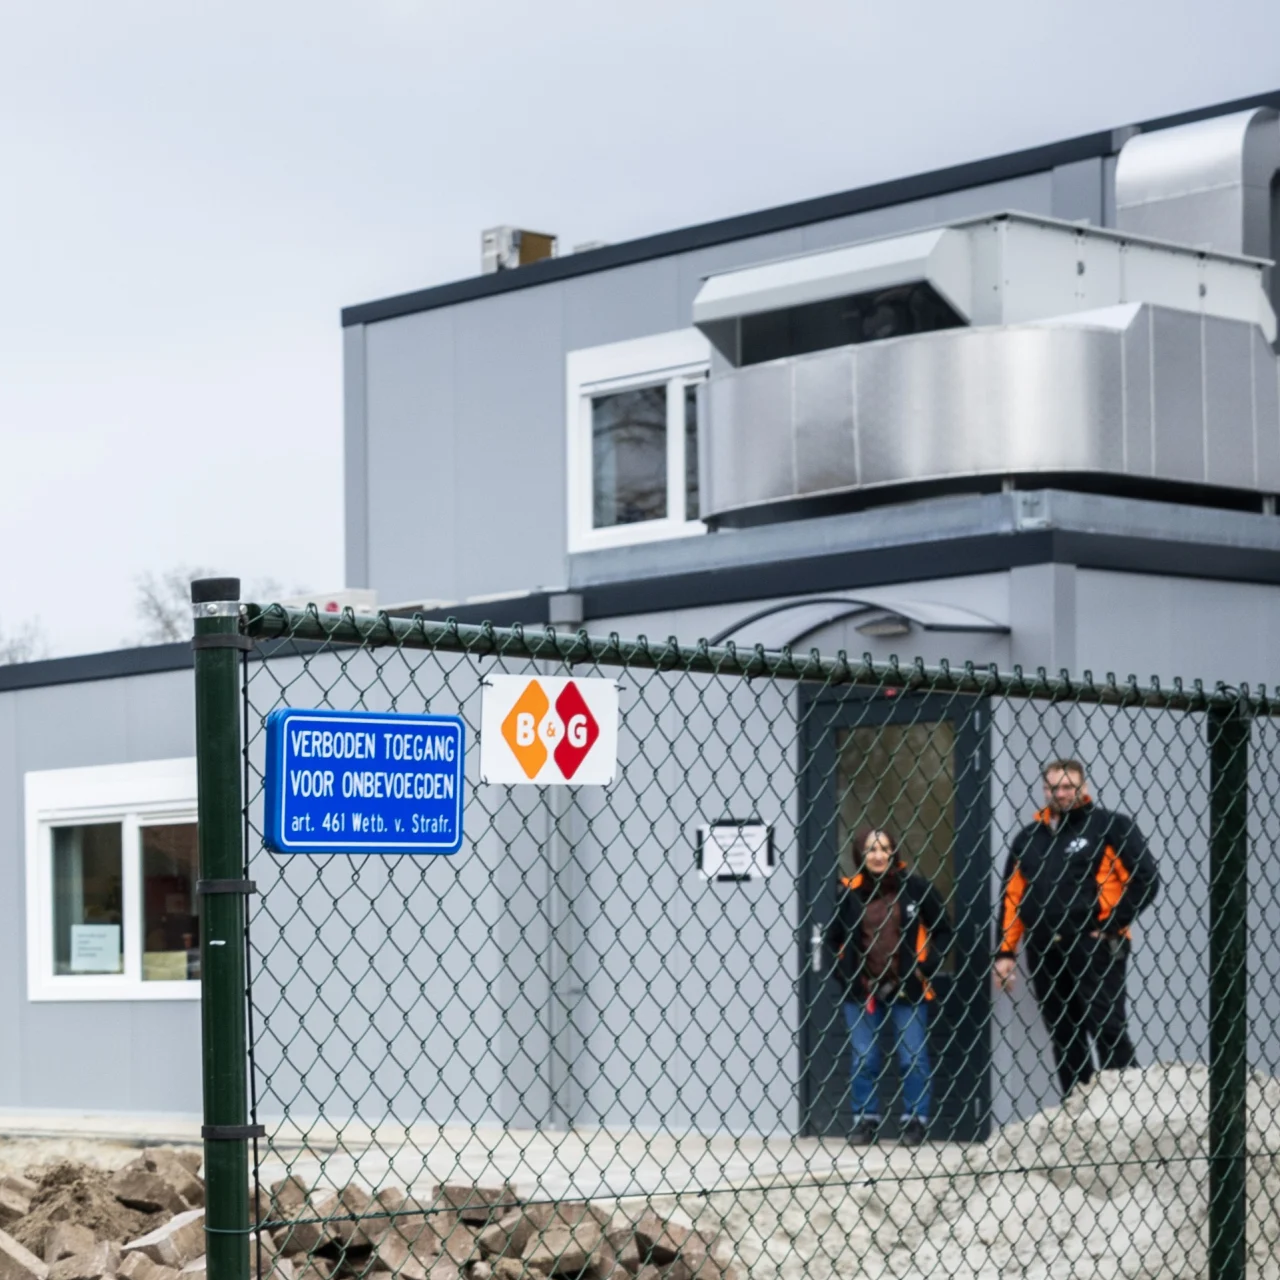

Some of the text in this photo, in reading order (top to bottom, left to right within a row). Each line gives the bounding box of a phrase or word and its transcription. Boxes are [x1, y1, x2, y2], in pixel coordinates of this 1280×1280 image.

[291, 730, 455, 762] VERBODEN TOEGANG
[290, 770, 454, 800] VOOR ONBEVOEGDEN
[291, 812, 452, 833] art. 461 Wetb. v. Strafr.
